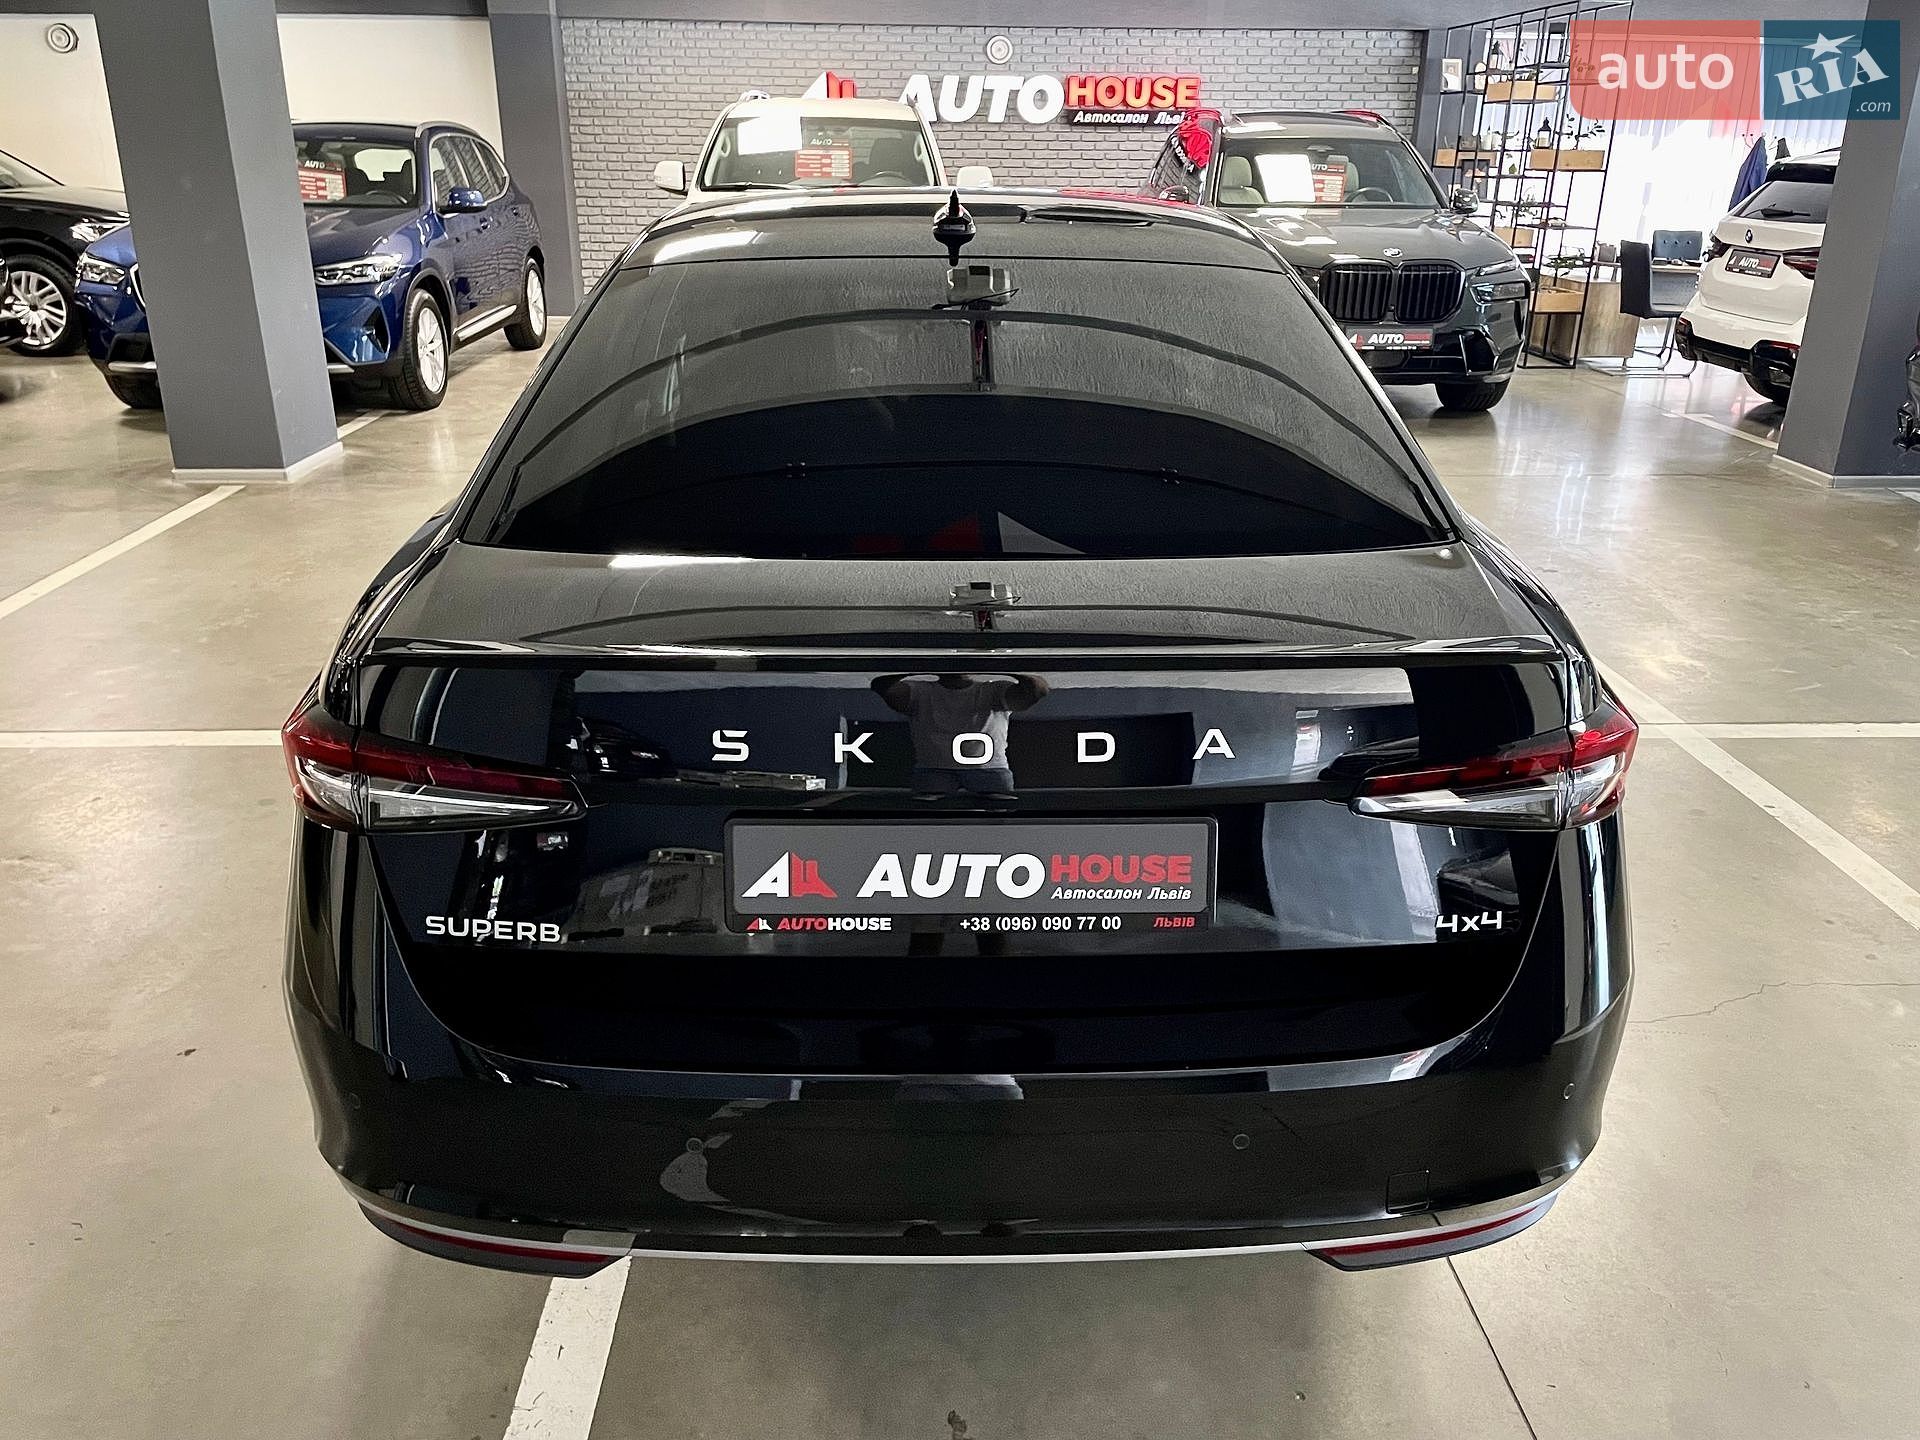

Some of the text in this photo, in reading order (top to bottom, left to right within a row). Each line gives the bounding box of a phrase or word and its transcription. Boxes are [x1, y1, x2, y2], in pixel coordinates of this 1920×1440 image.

[898, 74, 1200, 124] AUTO HOUSE
[1073, 110, 1148, 125] Автосалон
[304, 160, 325, 168] AUTO
[1739, 256, 1760, 268] AUTO
[1368, 333, 1404, 344] AUTO
[855, 853, 1193, 899] AUTO HOUSE
[1051, 886, 1192, 900] Автосалон Львів
[425, 915, 561, 943] SUPERB
[776, 917, 892, 931] AUTOHOUSE
[959, 916, 1122, 932] +38 (096) 090 77 00
[1436, 911, 1503, 933] 4x4
